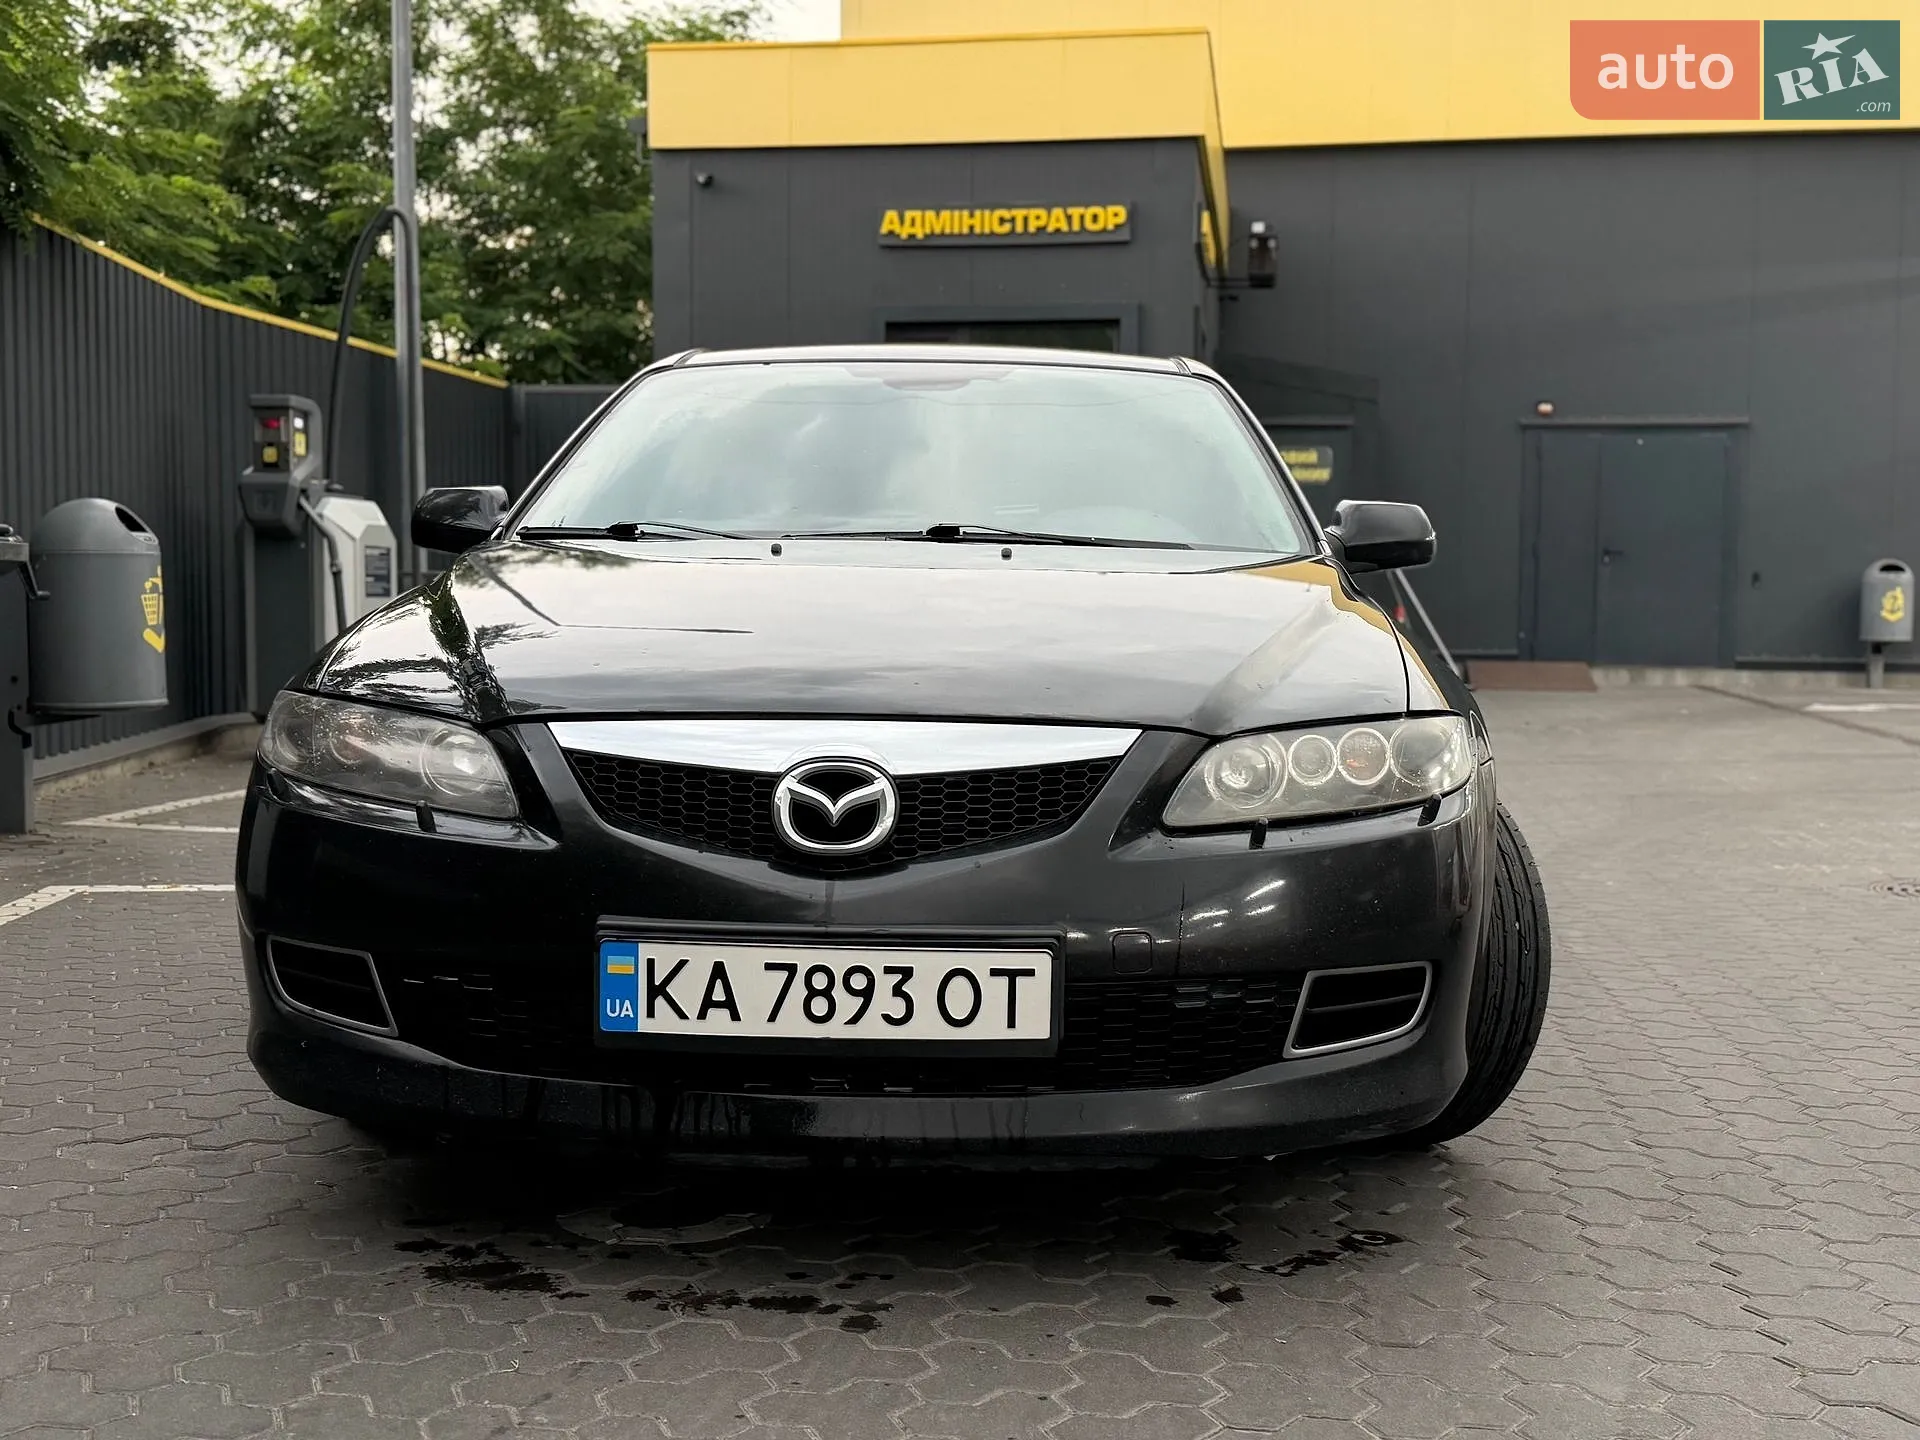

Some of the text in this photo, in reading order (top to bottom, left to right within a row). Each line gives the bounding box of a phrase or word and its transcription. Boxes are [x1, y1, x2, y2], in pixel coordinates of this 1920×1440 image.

[879, 205, 1128, 240] АДМІНІСТРАТОР
[606, 999, 634, 1018] UA
[645, 957, 1036, 1029] KA 7893 OT
